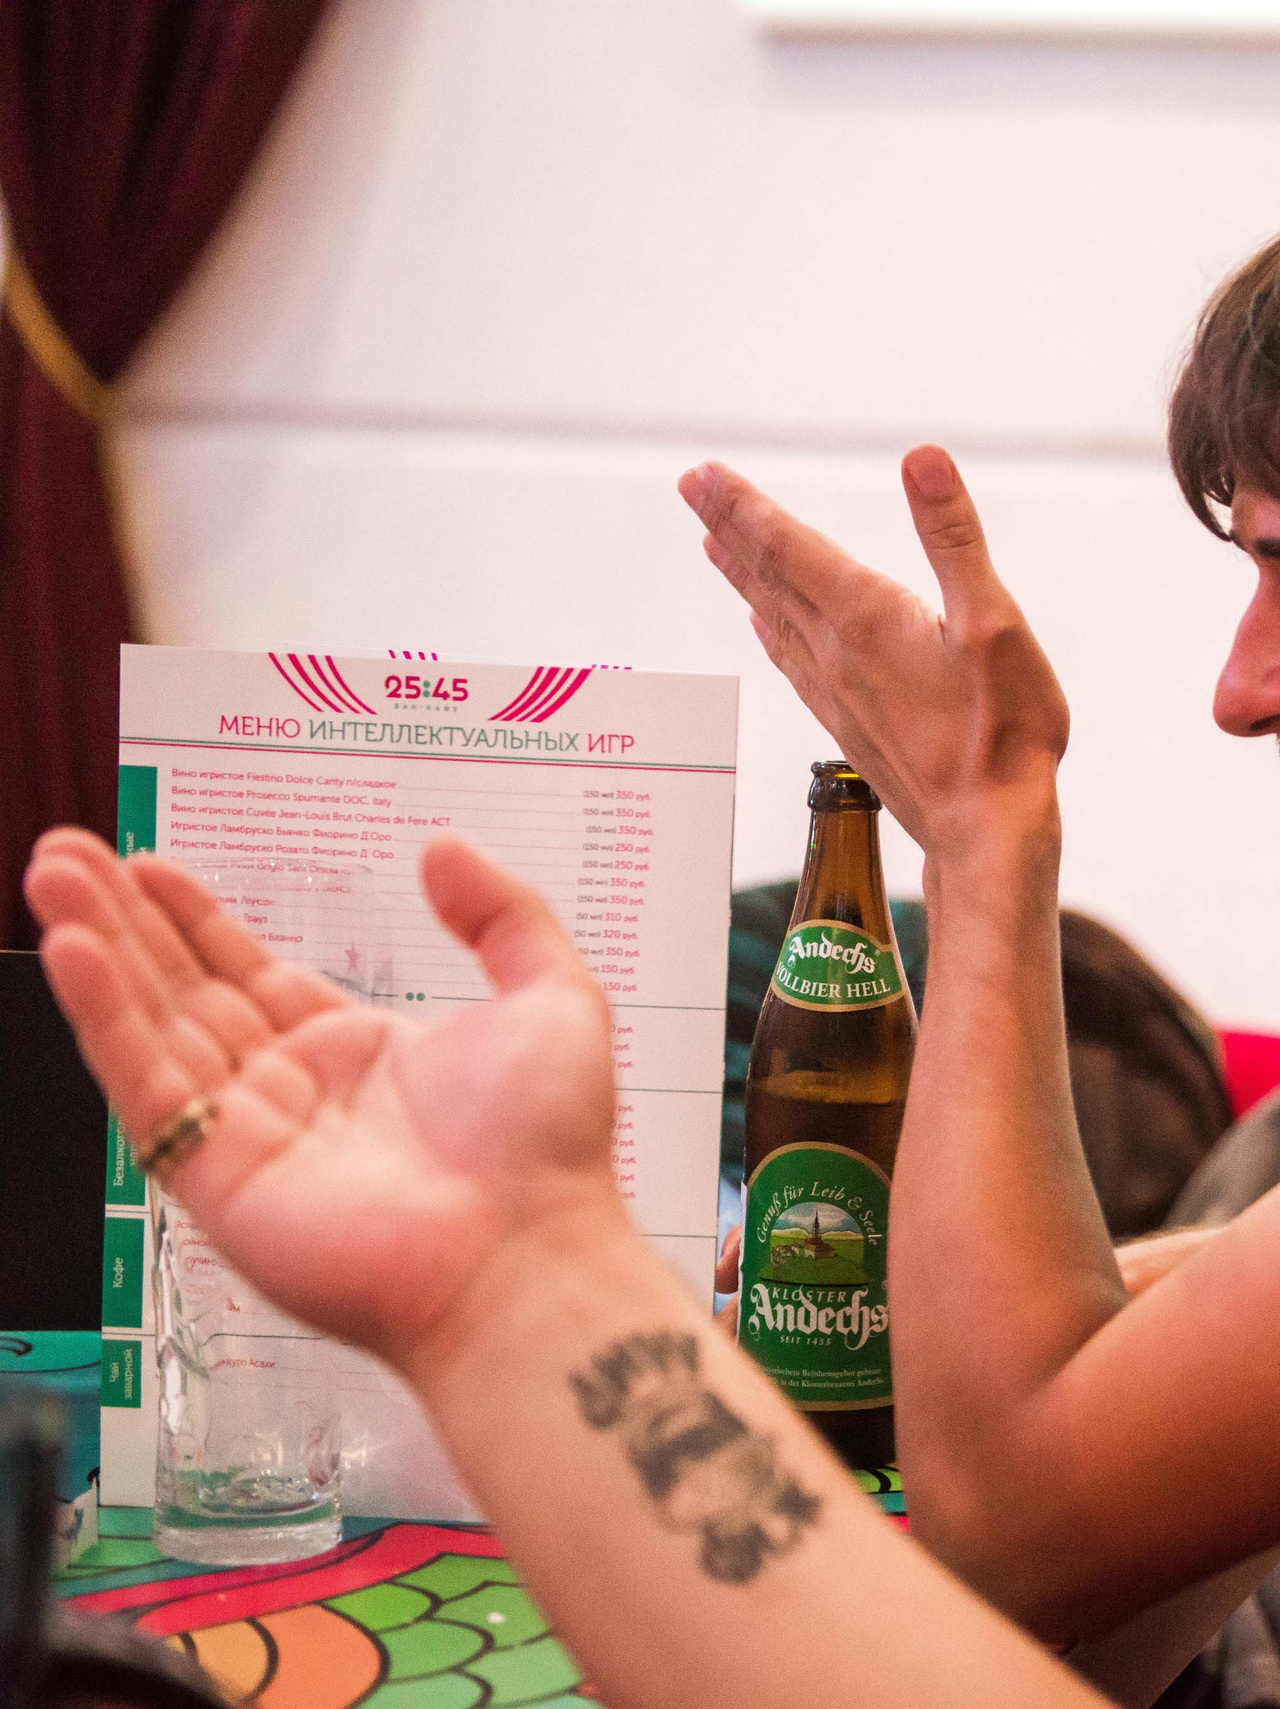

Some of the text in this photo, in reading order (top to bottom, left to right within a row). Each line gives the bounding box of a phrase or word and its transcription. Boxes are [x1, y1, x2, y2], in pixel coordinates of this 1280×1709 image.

[384, 674, 469, 702] 25:45
[218, 714, 635, 754] МЕНЮ ИНТЕЛЛЕКТУАЛЬНЫХ ИГР
[171, 767, 198, 779] Вино
[199, 771, 245, 781] игристое
[286, 774, 314, 785] Dolce
[615, 790, 634, 800] 350
[171, 785, 198, 796] Вино
[199, 789, 245, 799] игристое
[247, 790, 291, 801] Prosecco
[293, 792, 341, 805] Spumante
[615, 808, 634, 818] 350
[171, 803, 197, 813] Вино
[199, 806, 244, 816] игристое
[279, 809, 331, 821] Jean-Louis
[333, 812, 352, 823] Brut
[355, 813, 391, 825] Charles
[393, 816, 405, 826] de
[618, 825, 637, 835] 350
[170, 821, 218, 832] Игристое
[220, 823, 275, 836] Ламбруско
[276, 826, 310, 838] Бьянко
[312, 828, 360, 840] Фиорино
[614, 842, 634, 853] 250
[170, 838, 218, 850] Игристое
[219, 841, 274, 854] Ламбруско
[275, 843, 310, 855] Розато
[311, 846, 358, 860] Фиорино
[614, 860, 634, 870] 250
[609, 895, 629, 905] 350
[602, 929, 621, 939] 320
[605, 946, 624, 956] 350
[787, 930, 876, 975] Andechs
[600, 964, 619, 974] 150
[775, 961, 891, 999] VOLLBIER HELL
[602, 981, 621, 992] 150
[756, 1192, 782, 1244] Genuß
[783, 1184, 804, 1209] für
[809, 1181, 846, 1201] Leib
[858, 1209, 883, 1247] Seele
[112, 1256, 126, 1288] Кофе
[772, 1286, 847, 1304] KLOSTER
[747, 1282, 889, 1351] Andechs
[780, 1335, 832, 1346] SEIT 1455
[109, 1361, 120, 1384] Чай
[124, 1348, 134, 1400] заварной
